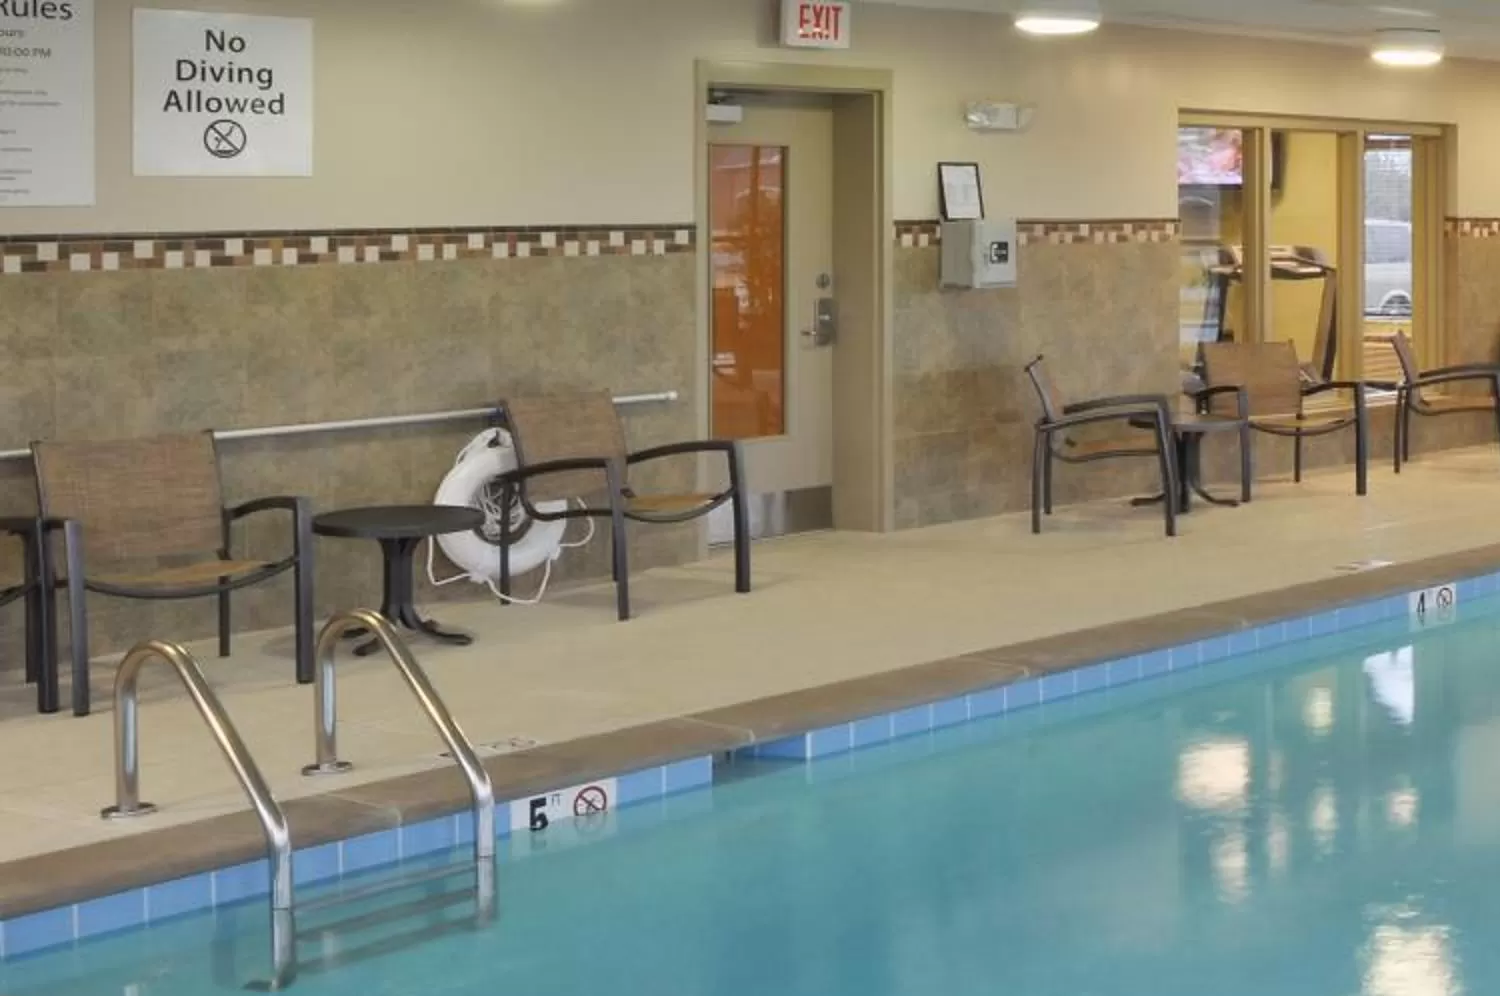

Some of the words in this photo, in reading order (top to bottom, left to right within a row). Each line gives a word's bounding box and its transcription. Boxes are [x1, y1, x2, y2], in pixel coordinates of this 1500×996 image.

[799, 4, 843, 40] EXIT
[205, 29, 246, 52] No
[176, 59, 273, 90] Diving
[163, 89, 286, 115] Allowed
[529, 796, 549, 832] 5
